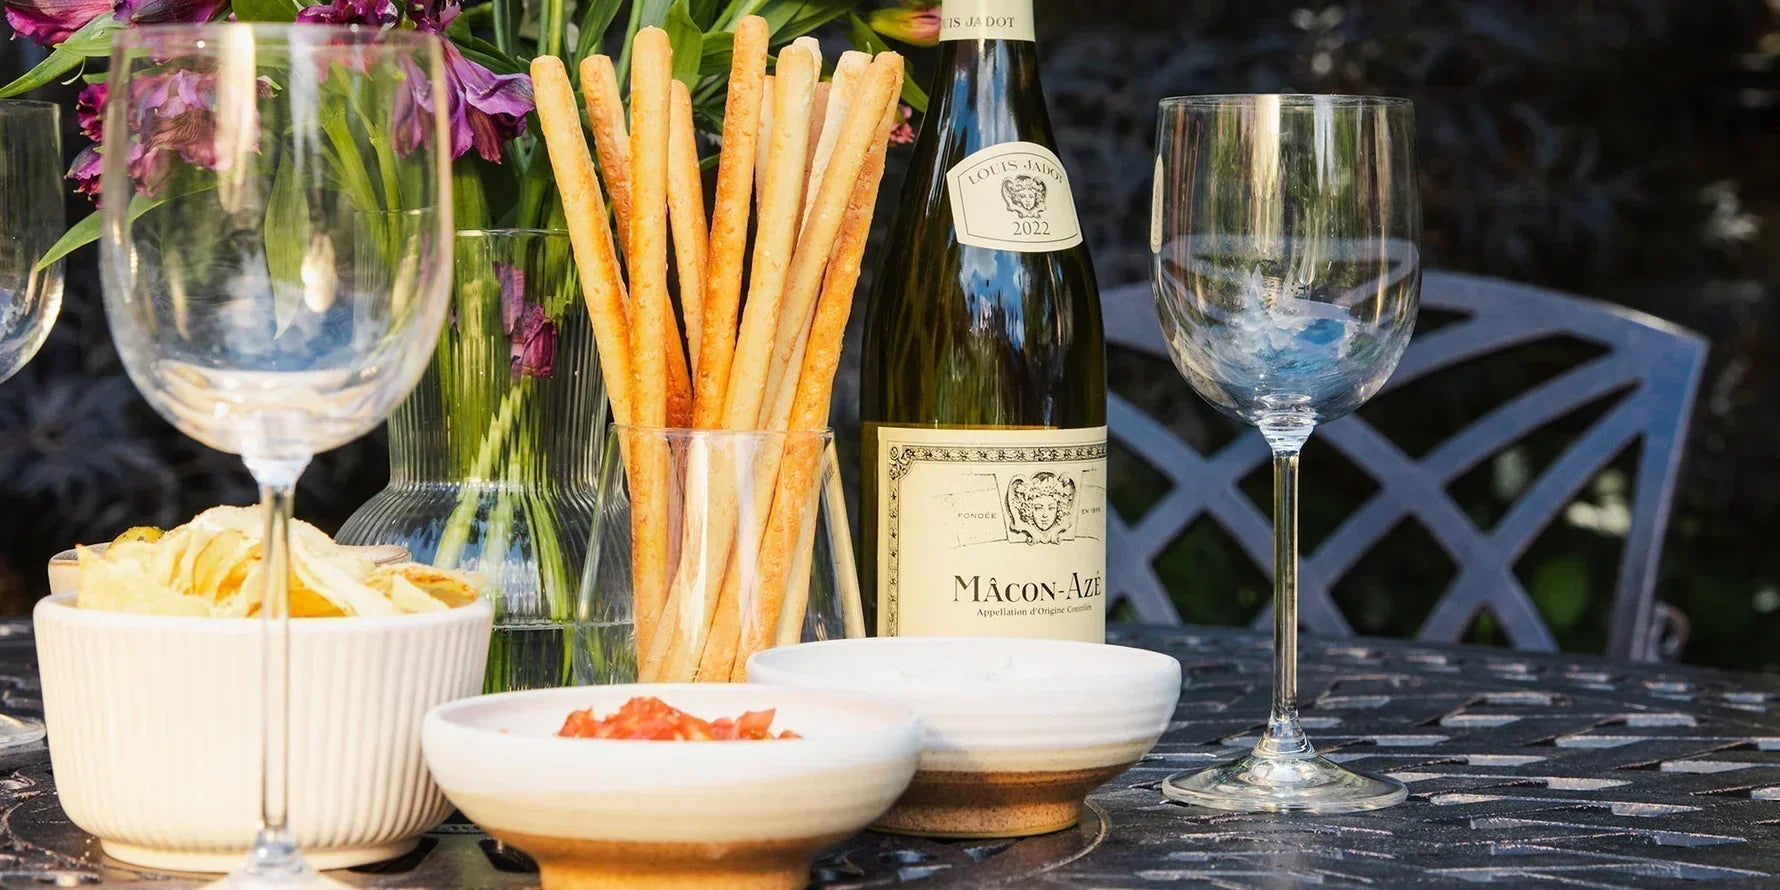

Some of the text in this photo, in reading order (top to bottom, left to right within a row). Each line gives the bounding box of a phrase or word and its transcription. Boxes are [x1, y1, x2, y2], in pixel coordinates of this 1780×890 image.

[965, 16, 1015, 28] JADOT
[968, 160, 1018, 185] LOUIS
[1013, 221, 1051, 236] 2022
[977, 608, 1028, 618] Appellation
[1029, 605, 1065, 616] d'Origine
